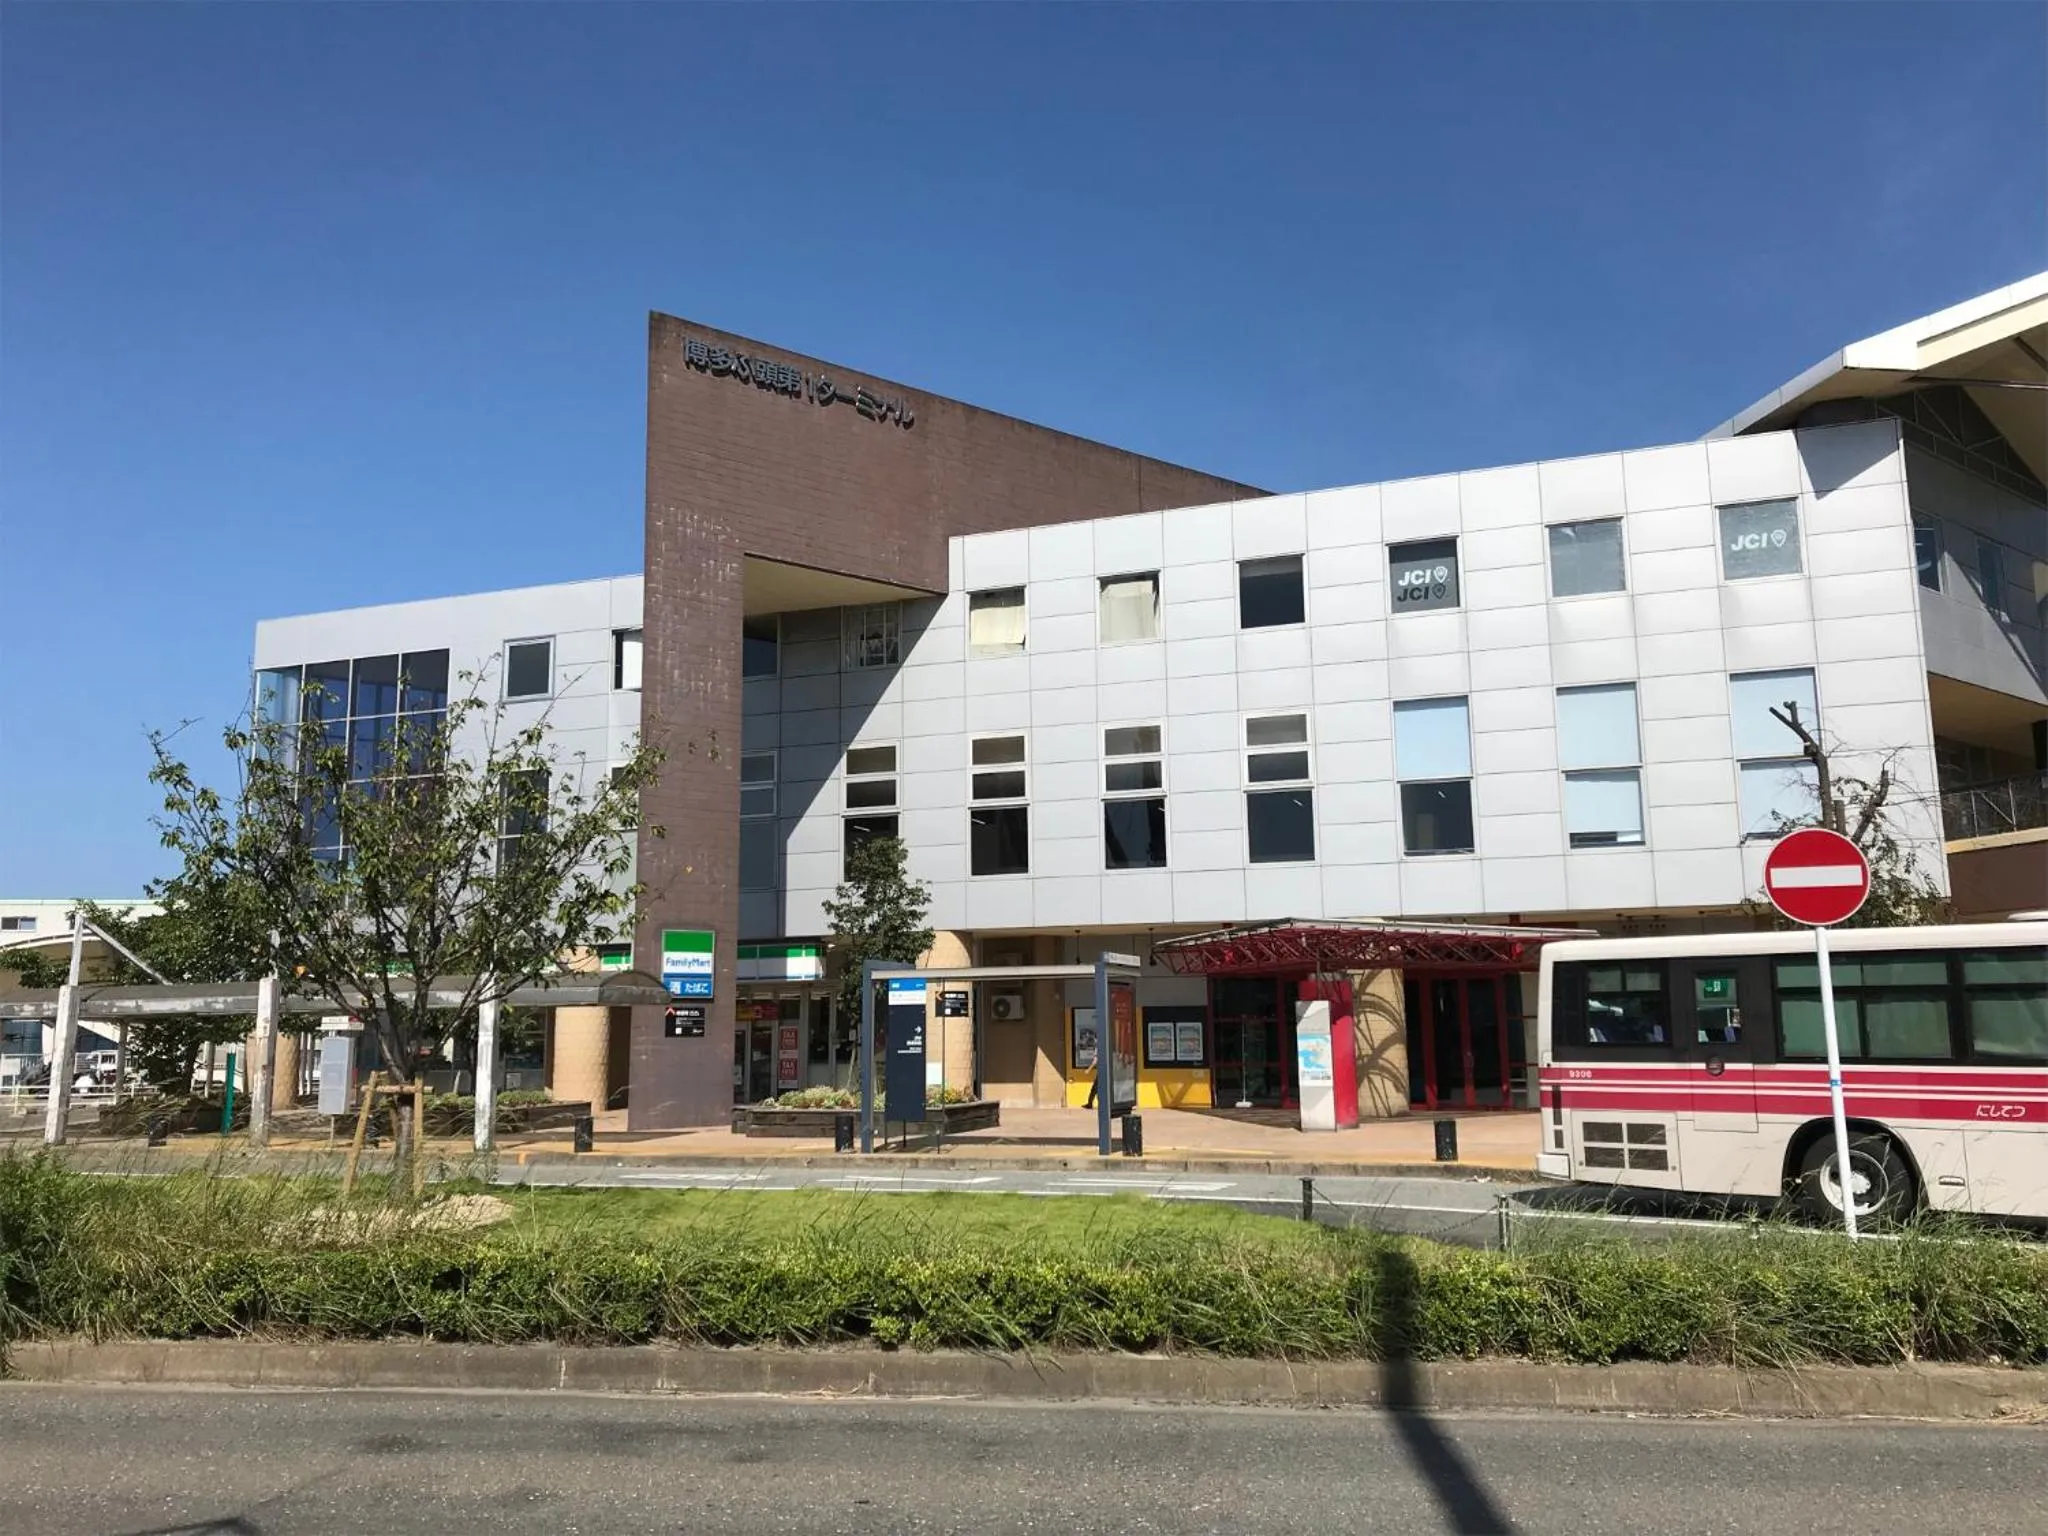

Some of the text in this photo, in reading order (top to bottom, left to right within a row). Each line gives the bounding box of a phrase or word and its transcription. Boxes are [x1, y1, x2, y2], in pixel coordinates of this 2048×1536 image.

[1731, 532, 1768, 551] JCI
[1398, 568, 1432, 586] JCI
[1397, 586, 1430, 602] JCI
[665, 956, 711, 969] FamilyMart
[1976, 1104, 2026, 1118] にしてつ
